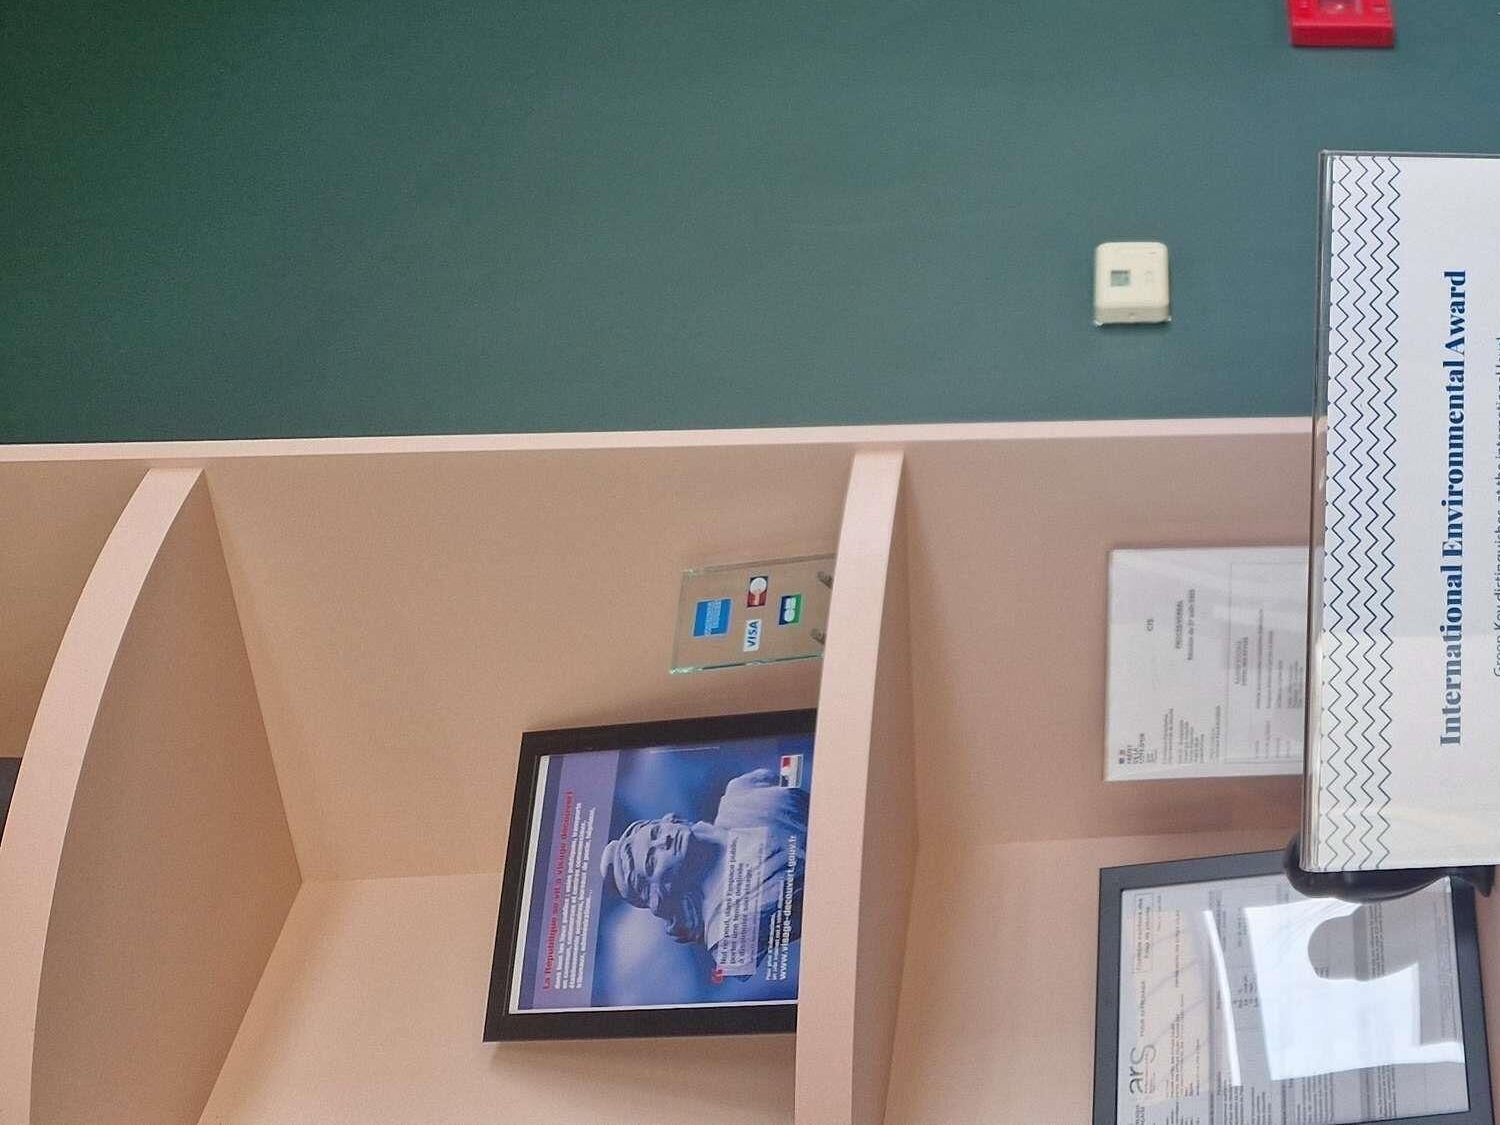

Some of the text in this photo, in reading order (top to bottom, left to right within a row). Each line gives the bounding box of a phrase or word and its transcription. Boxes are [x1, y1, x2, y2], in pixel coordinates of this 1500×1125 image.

[1439, 271, 1465, 747] International Environmental Award
[746, 620, 760, 648] VISA
[1128, 1044, 1157, 1094] ars
